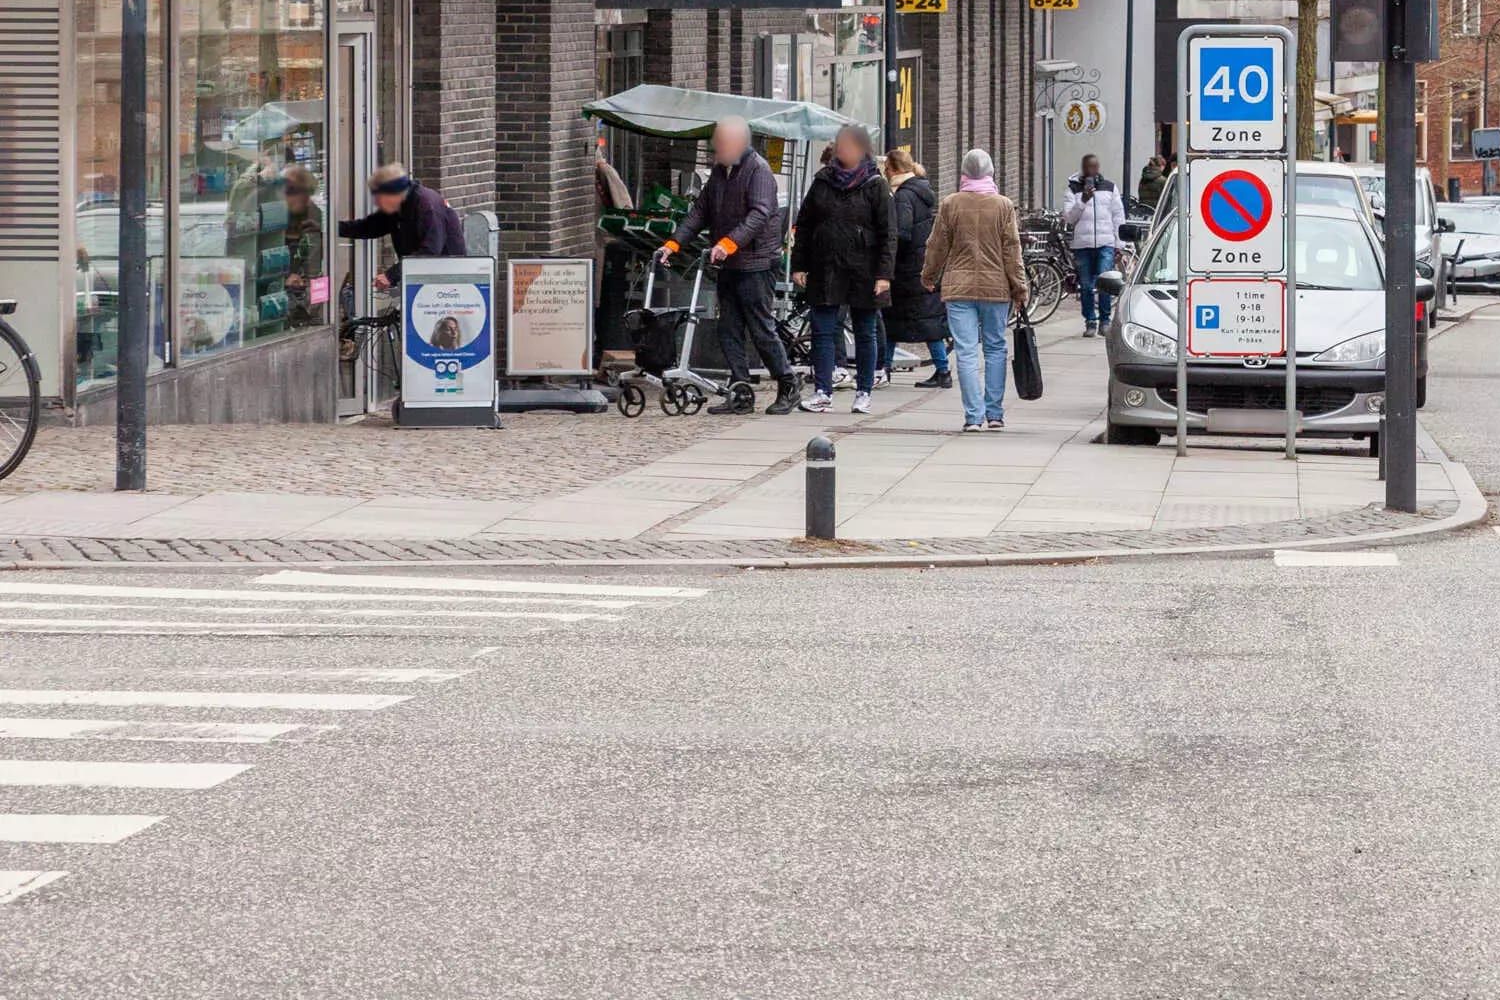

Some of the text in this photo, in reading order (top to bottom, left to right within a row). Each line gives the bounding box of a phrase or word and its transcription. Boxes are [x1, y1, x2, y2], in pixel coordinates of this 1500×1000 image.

[1203, 64, 1269, 104] 40
[1211, 127, 1262, 142] Zone
[1211, 248, 1262, 263] Zone
[1244, 291, 1265, 300] time
[1240, 303, 1261, 311] 9-18
[1201, 308, 1215, 327] P
[1236, 315, 1265, 324] (9-14)
